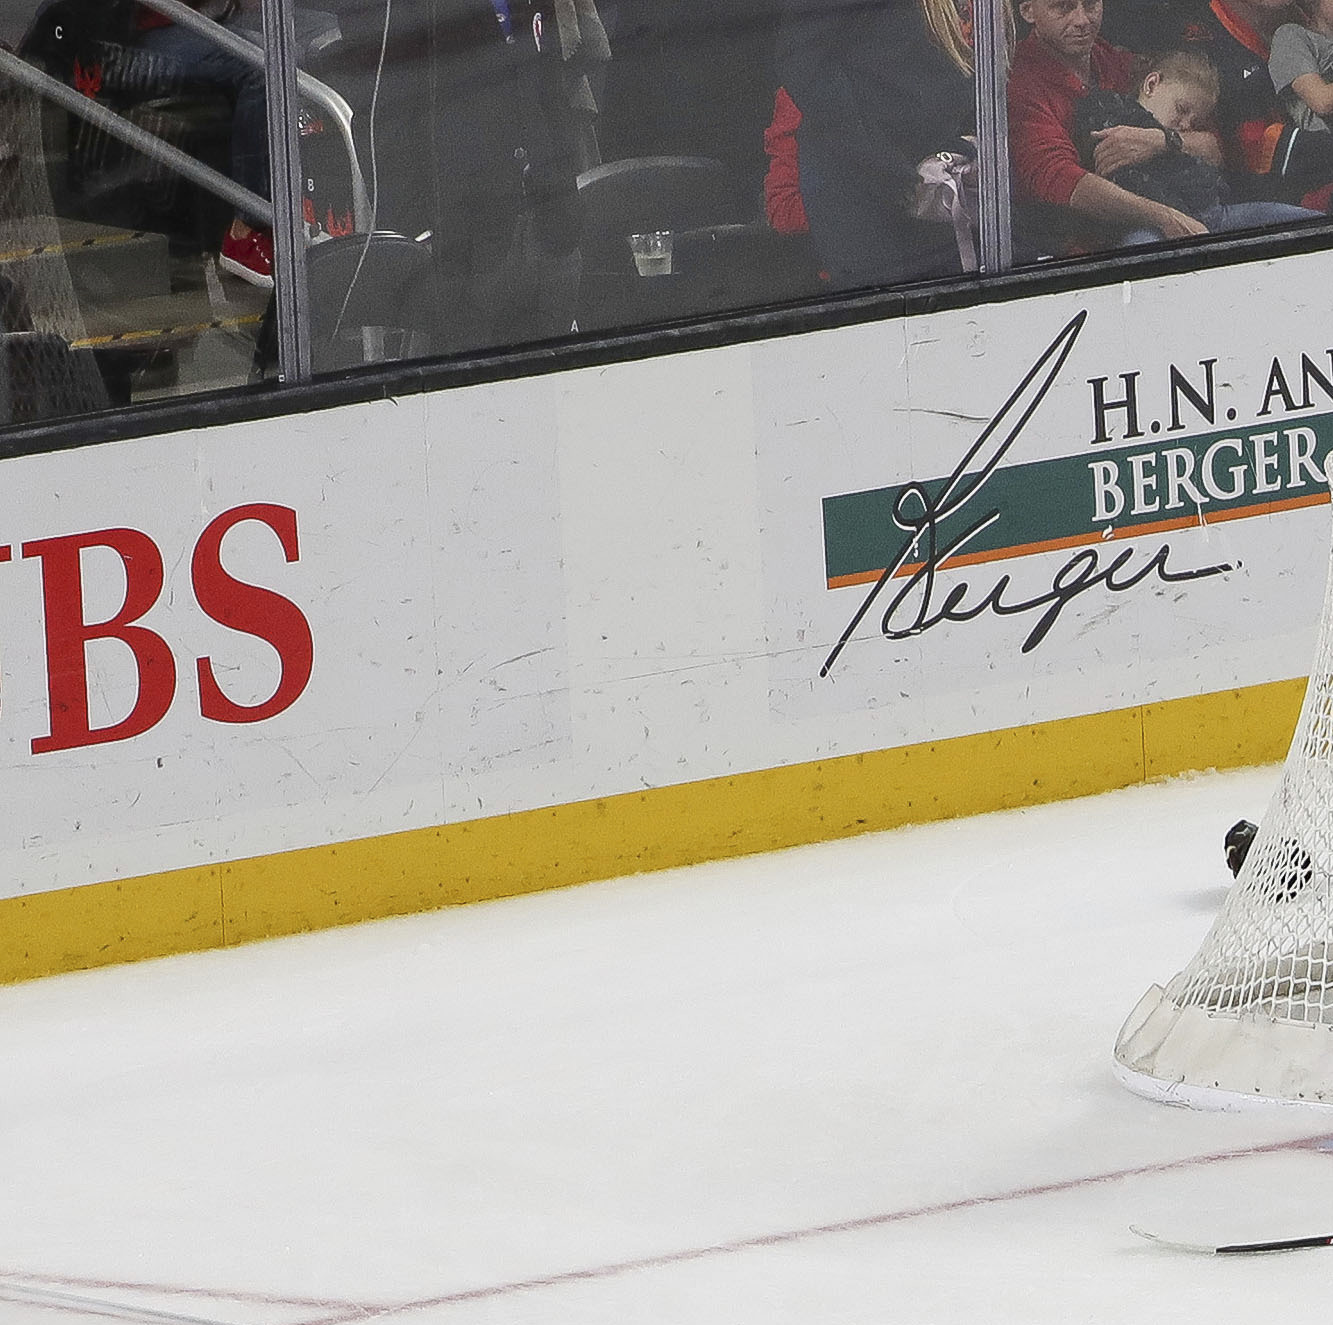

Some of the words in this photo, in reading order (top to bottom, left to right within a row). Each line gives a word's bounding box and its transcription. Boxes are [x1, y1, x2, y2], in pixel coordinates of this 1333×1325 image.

[54, 25, 64, 40] C
[1087, 357, 1238, 446] H.N.
[1088, 425, 1332, 523] BERGER
[0, 501, 315, 756] BS
